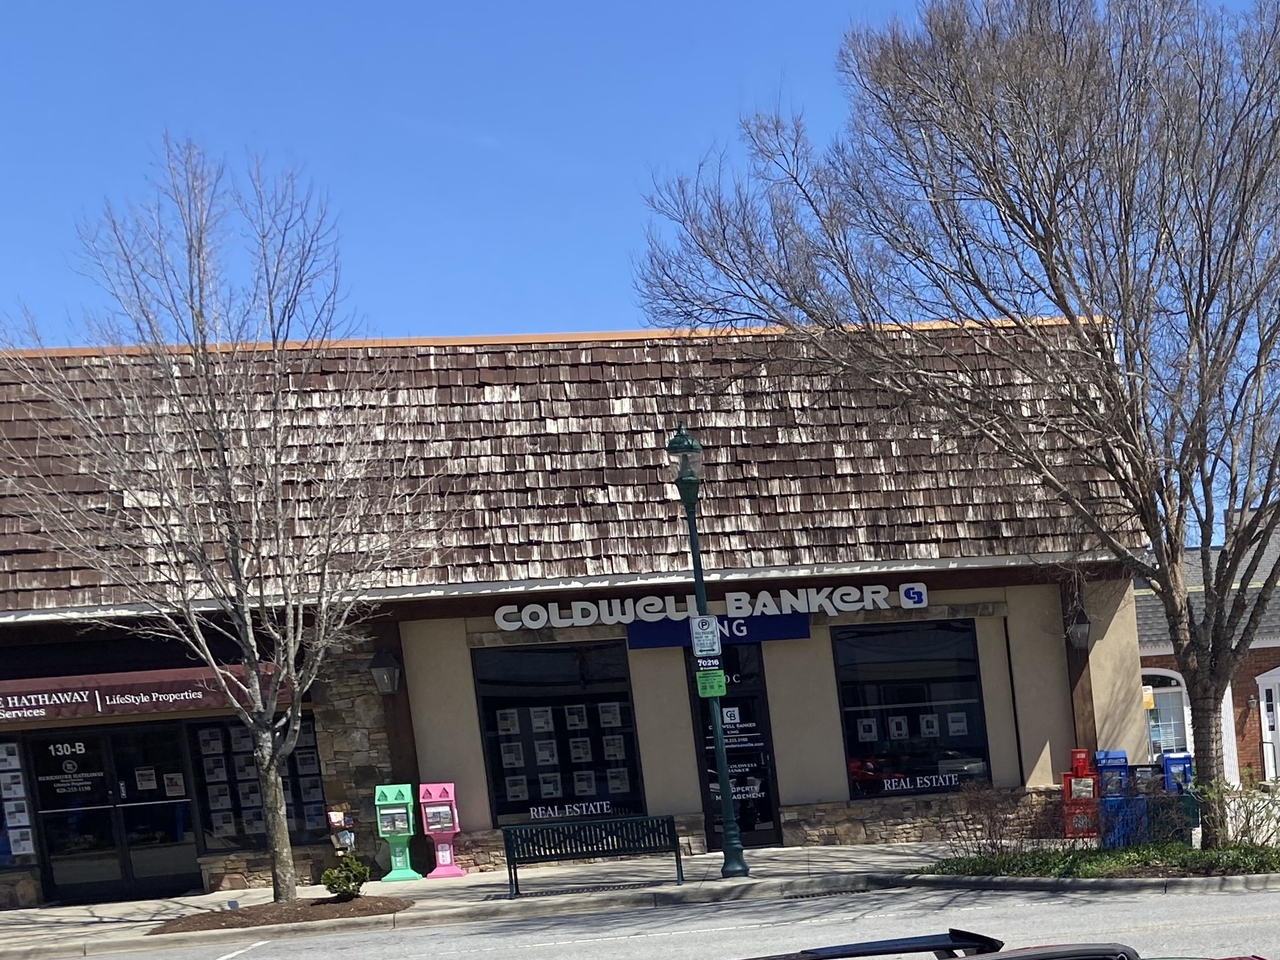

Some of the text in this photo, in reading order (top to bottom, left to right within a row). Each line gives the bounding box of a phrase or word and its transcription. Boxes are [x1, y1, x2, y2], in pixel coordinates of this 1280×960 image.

[718, 619, 747, 637] NG
[7, 691, 89, 707] HATHAWAY
[106, 692, 150, 705] LifeStyle
[152, 690, 203, 702] Properties
[0, 707, 46, 718] Services
[48, 742, 85, 756] 130-B
[883, 774, 959, 791] REAL ESTATE
[715, 792, 765, 801] MAGEMENT
[529, 801, 612, 820] REAL ESTATE
